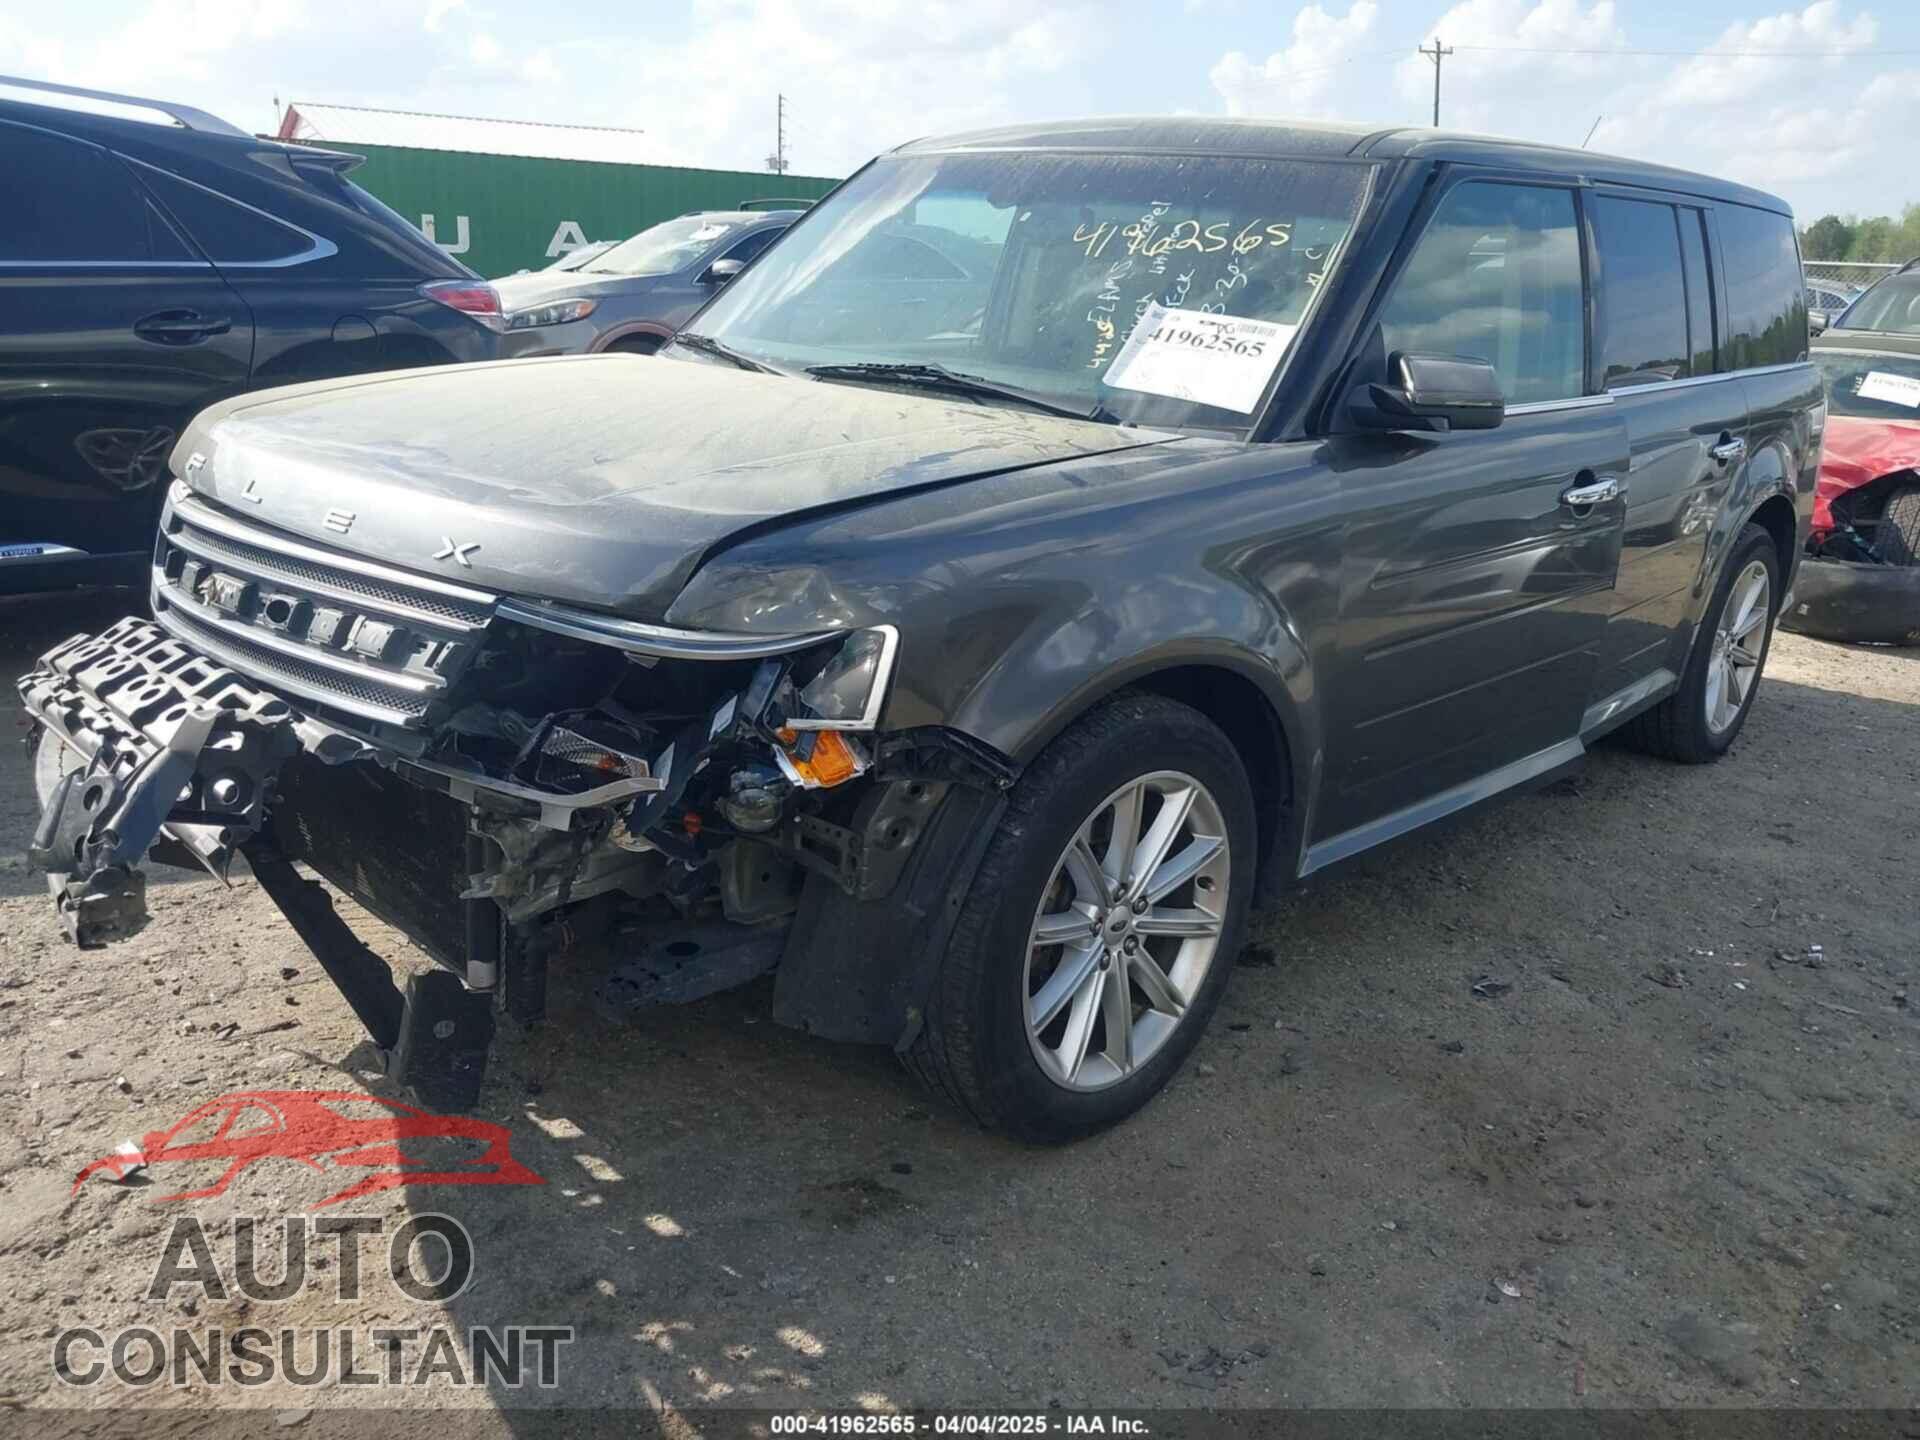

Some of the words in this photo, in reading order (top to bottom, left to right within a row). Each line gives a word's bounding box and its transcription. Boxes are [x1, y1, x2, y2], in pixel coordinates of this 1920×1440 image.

[1072, 218, 1292, 257] 41962565
[1148, 326, 1268, 358] 41962565
[185, 452, 482, 569] FLEX
